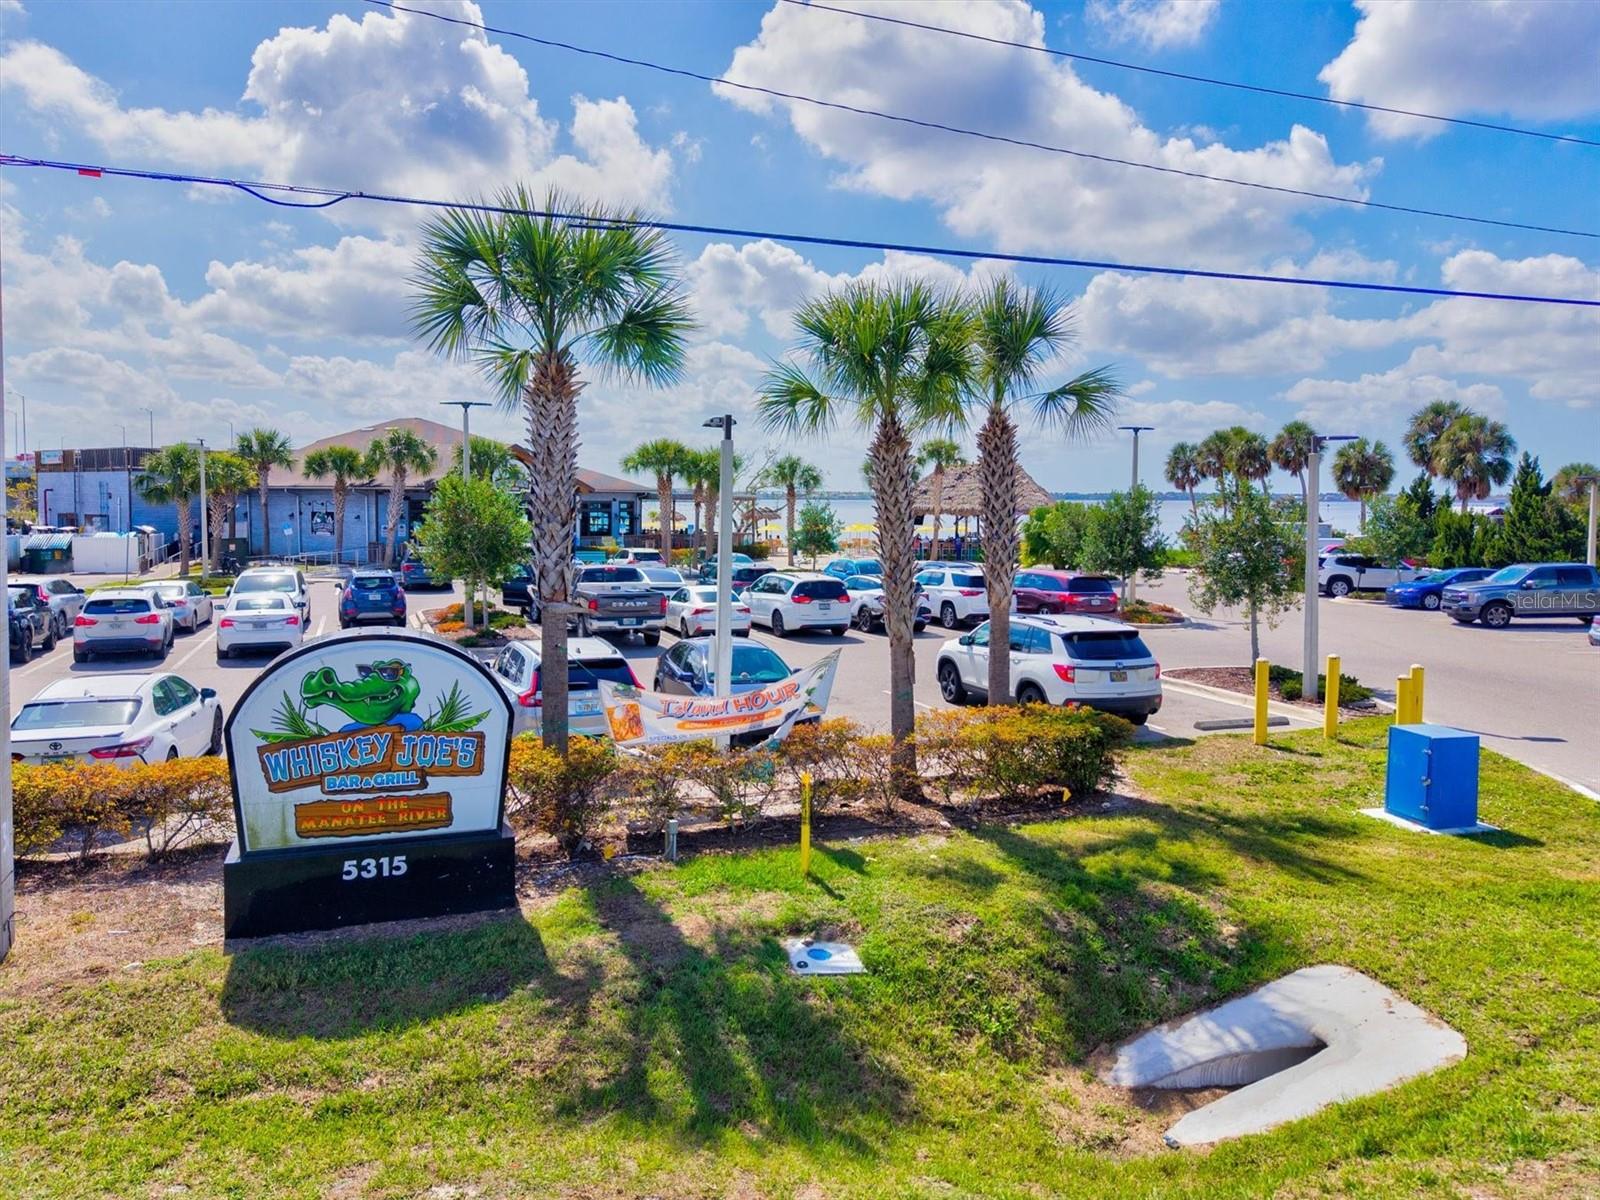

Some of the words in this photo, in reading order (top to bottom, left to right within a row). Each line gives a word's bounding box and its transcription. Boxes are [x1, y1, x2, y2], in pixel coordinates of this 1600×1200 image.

[733, 680, 800, 713] HOUR
[264, 732, 392, 783] WHISKEY
[396, 734, 479, 769] JOE'S
[326, 774, 360, 791] BAR
[374, 770, 419, 787] GRILL
[301, 811, 387, 830] MANATEE
[398, 805, 447, 823] RIVER
[340, 801, 364, 814] ON
[376, 797, 409, 812] THE
[342, 855, 408, 881] 5315
